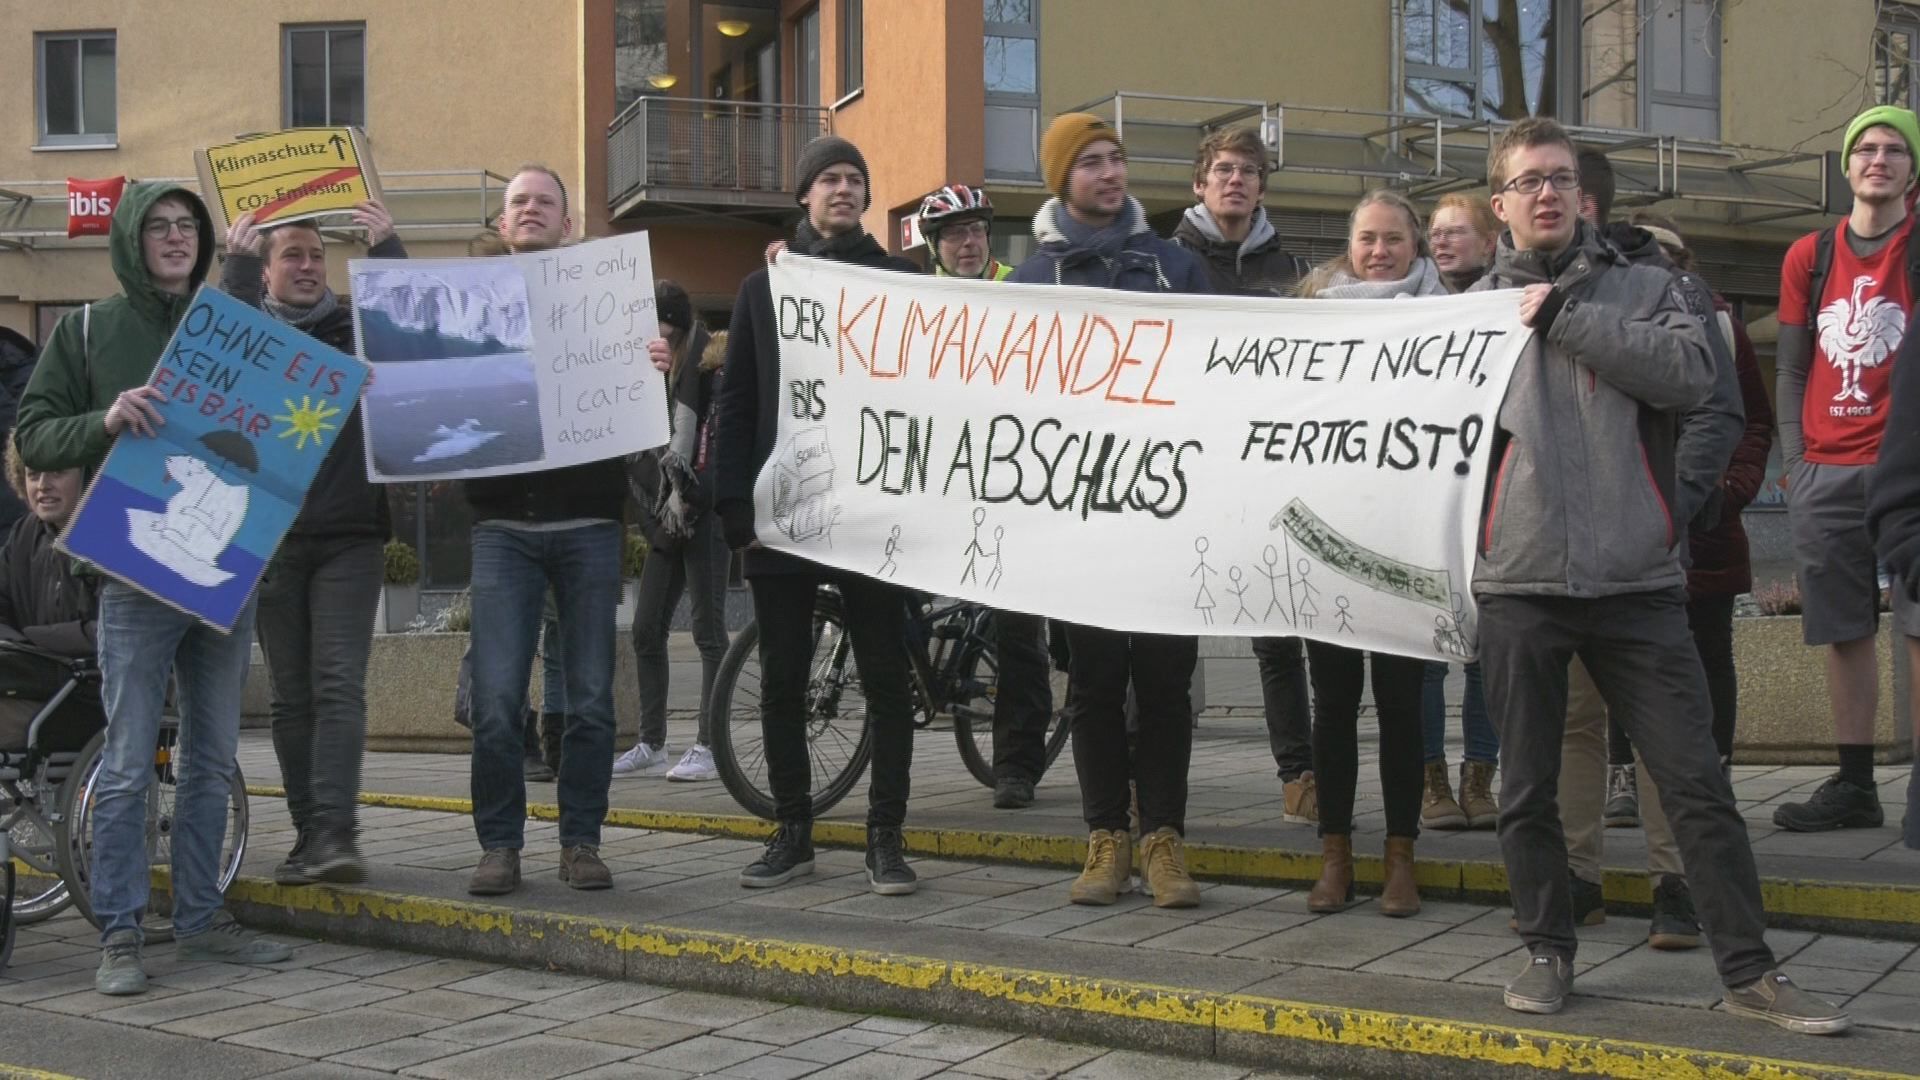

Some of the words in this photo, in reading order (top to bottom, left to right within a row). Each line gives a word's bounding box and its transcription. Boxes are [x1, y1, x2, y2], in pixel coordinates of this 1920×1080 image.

[215, 142, 328, 174] Klimaschutz
[70, 191, 112, 217] ibis
[539, 256, 583, 286] The
[595, 247, 637, 280] only
[184, 302, 286, 372] OHNE
[283, 351, 347, 398] EIS
[551, 336, 644, 374] challenge
[779, 294, 832, 349] DER
[837, 286, 1177, 406] KLIMAWANDEL
[1204, 336, 1365, 383] WARTET
[1371, 329, 1507, 388] NICHT,
[167, 340, 241, 394] KEIN
[150, 367, 272, 438] EISBÄR
[576, 379, 646, 413] care
[557, 416, 617, 445] about
[789, 379, 827, 421] BIS
[943, 414, 1204, 521] ABSCHLUSS
[1240, 419, 1369, 465] FERTIG
[1376, 413, 1484, 477] IST!
